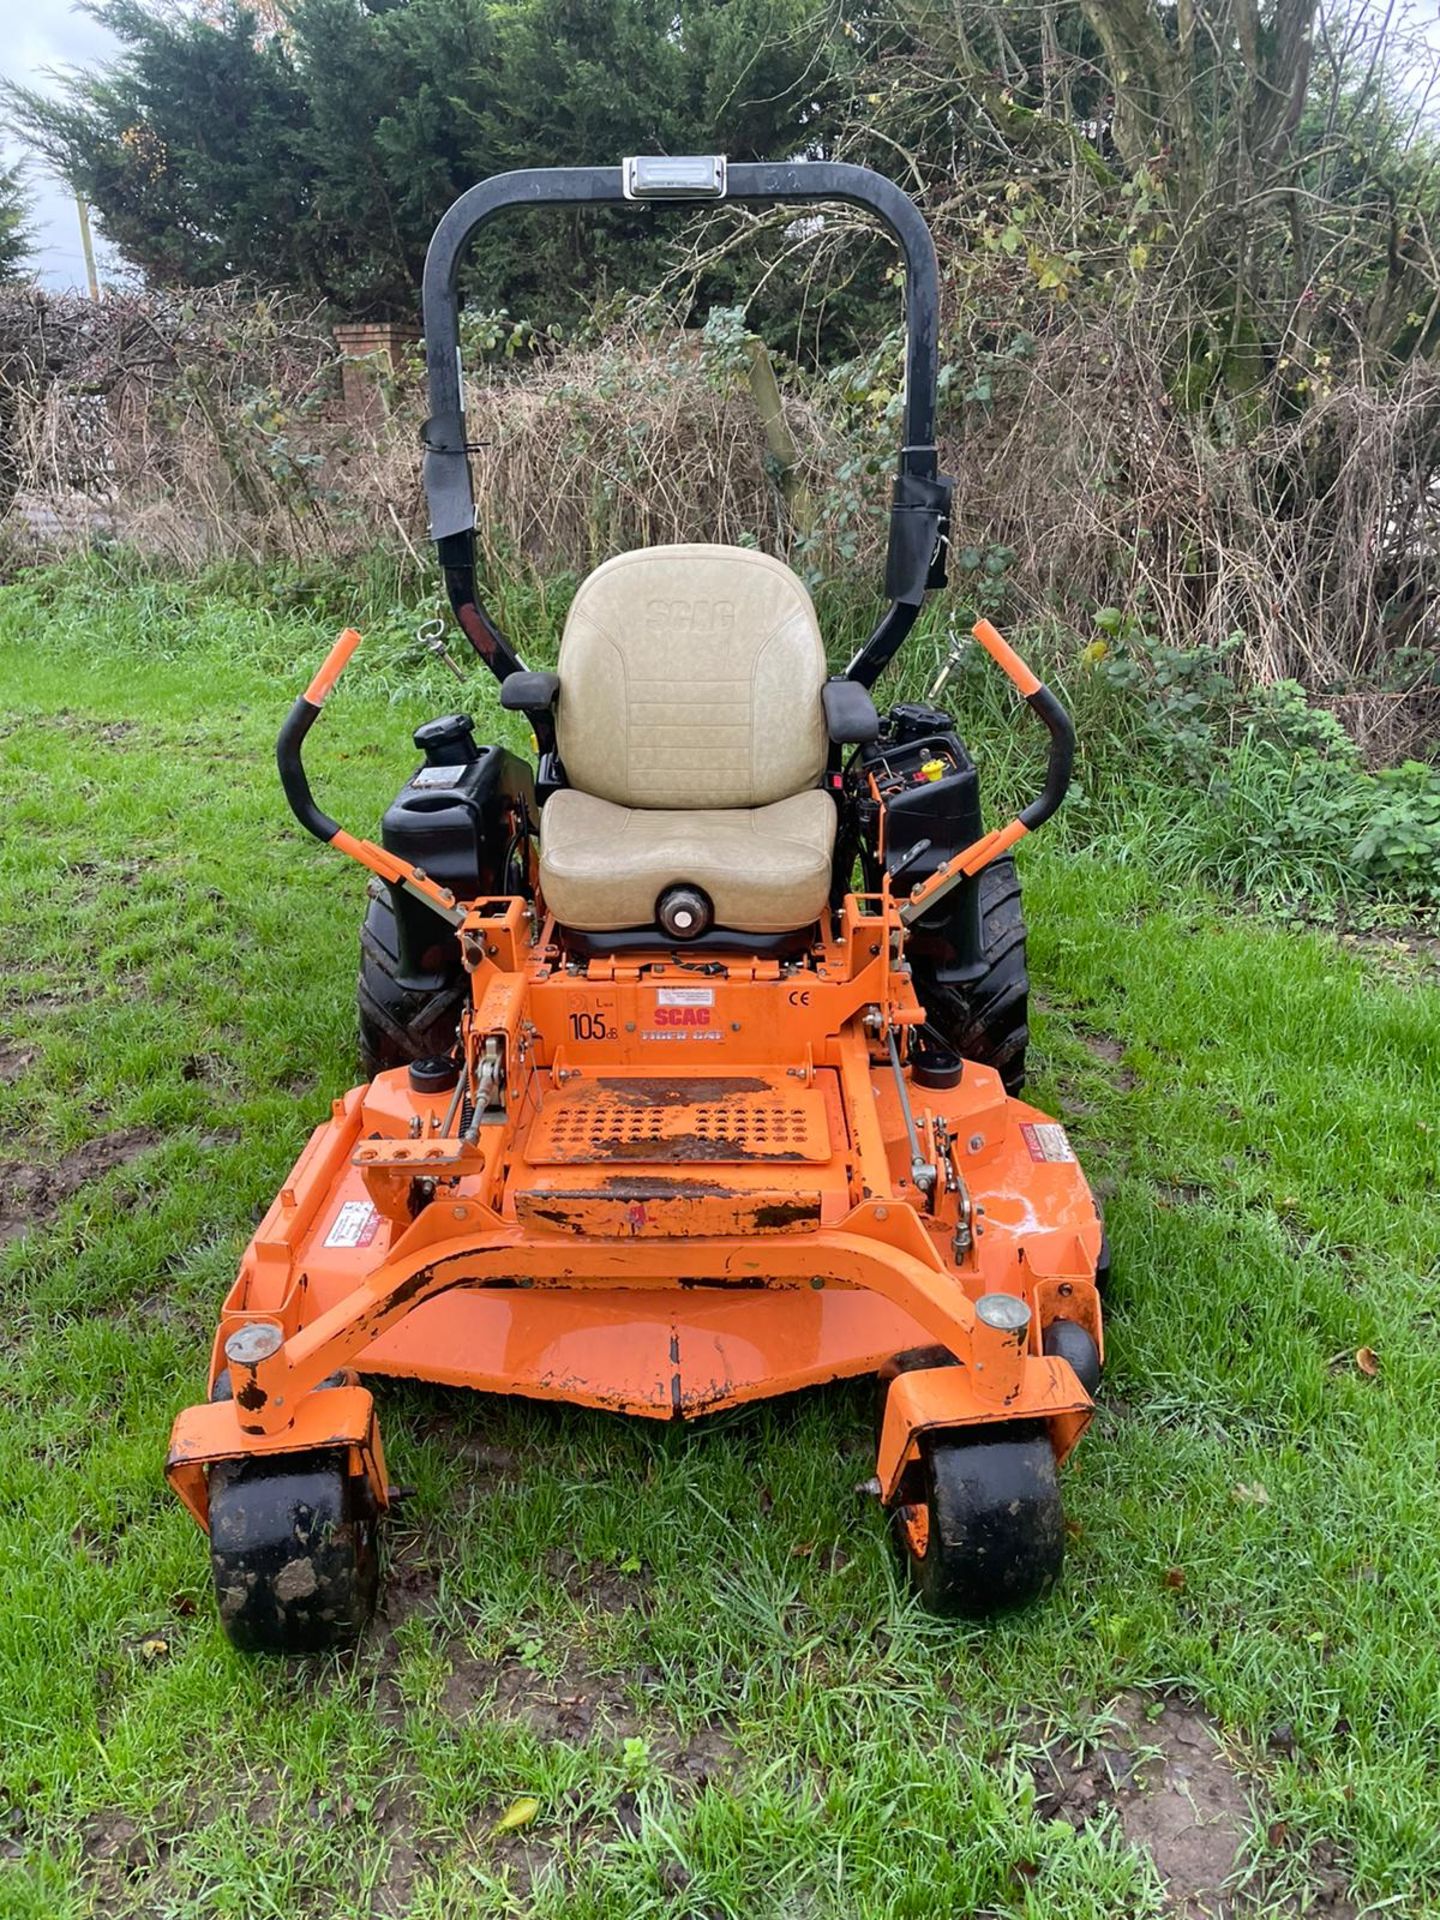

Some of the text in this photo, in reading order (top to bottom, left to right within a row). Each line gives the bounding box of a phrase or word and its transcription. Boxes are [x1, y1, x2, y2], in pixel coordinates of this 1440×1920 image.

[646, 600, 736, 632] SCAG
[788, 991, 810, 1006] CE
[653, 1008, 711, 1026] SCAG
